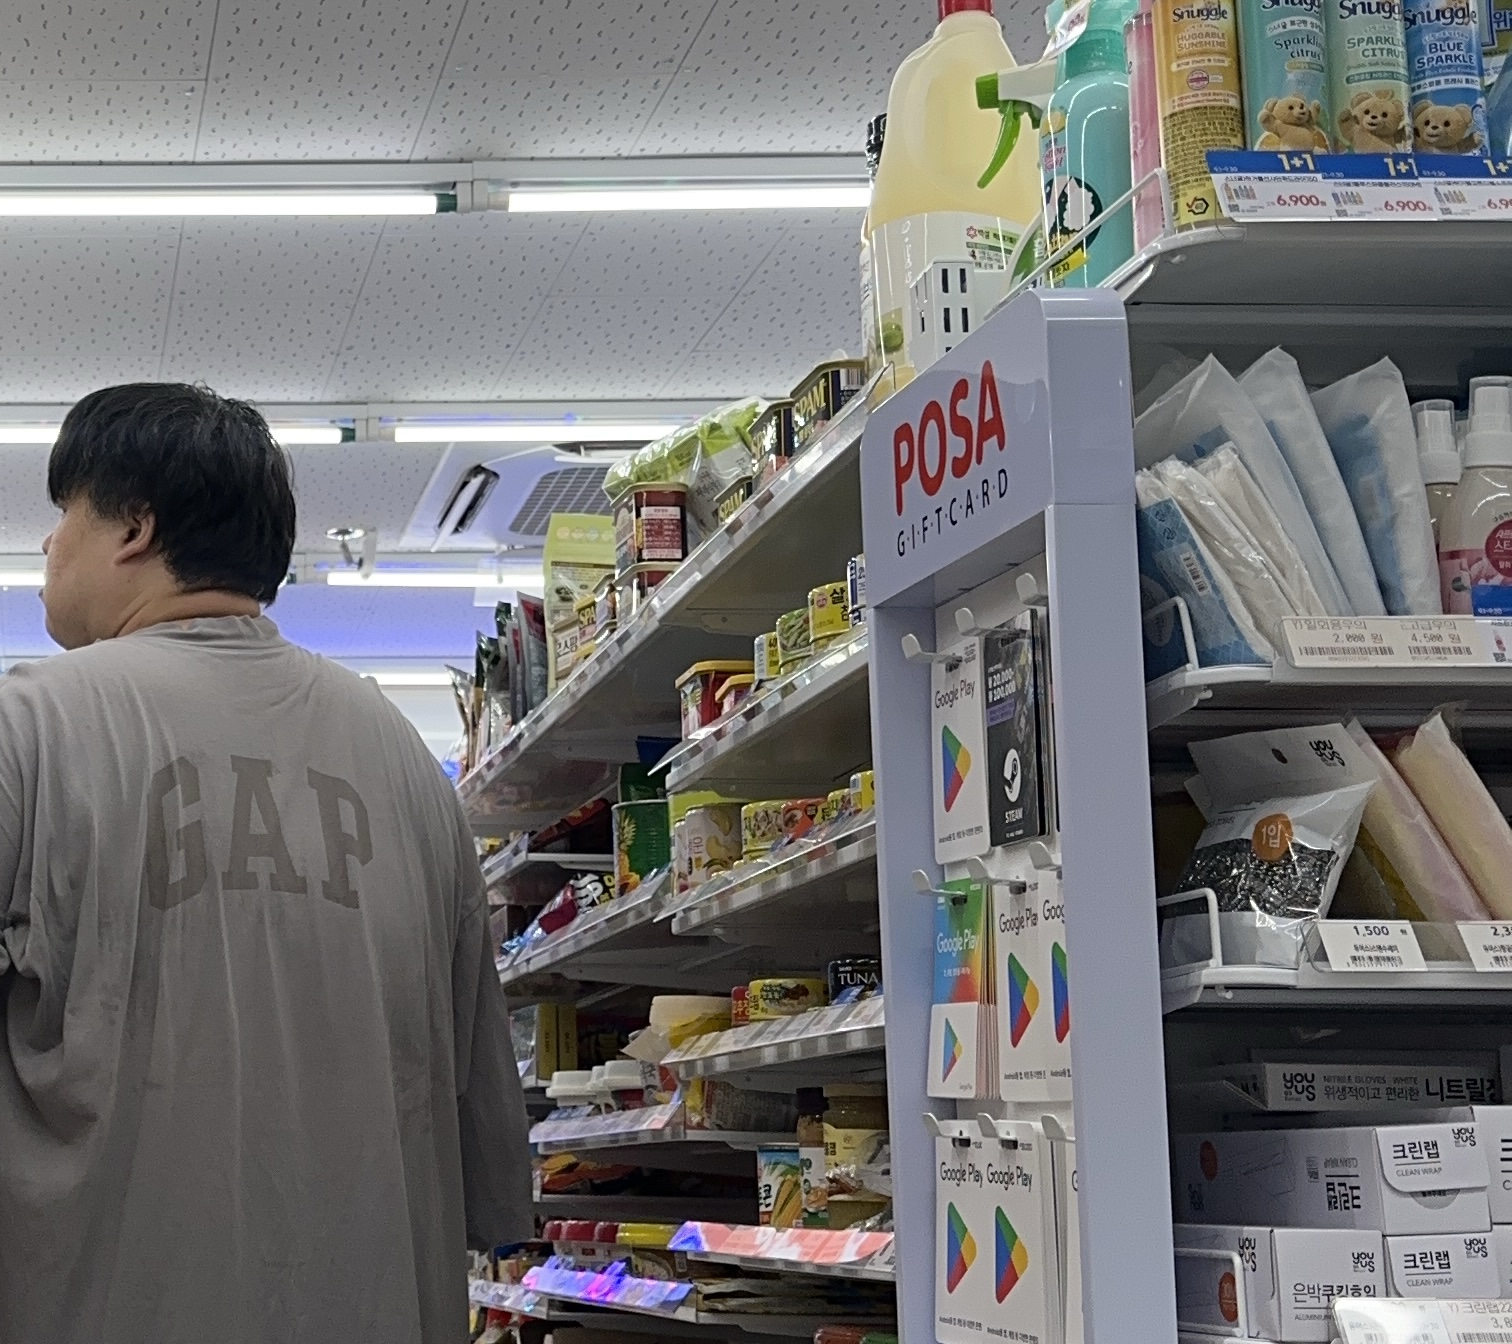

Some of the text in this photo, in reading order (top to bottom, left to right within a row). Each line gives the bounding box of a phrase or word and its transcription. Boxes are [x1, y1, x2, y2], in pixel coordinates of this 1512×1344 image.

[1172, 0, 1229, 23] Snuggle
[1428, 41, 1464, 55] BLUE
[1416, 54, 1476, 70] SPARKLE
[1278, 153, 1419, 176] 1+1 1+1
[792, 378, 827, 422] SPAM
[893, 359, 1006, 517] POSA
[578, 606, 596, 628] SPA
[1371, 632, 1384, 644] 원
[1449, 632, 1462, 644] 원
[935, 678, 976, 709] Google Play
[1004, 806, 1024, 825] STEAM
[146, 756, 375, 913] GAP
[1260, 820, 1284, 849] 1입
[999, 912, 1024, 937] Google
[1353, 925, 1390, 938] 1,500
[937, 928, 980, 958] Google Play
[838, 972, 879, 986] TUNA
[1282, 1072, 1316, 1089] you
[1354, 1075, 1387, 1085] GLOVES
[1393, 1076, 1418, 1085] WHITE
[1323, 1086, 1420, 1102] 위생적이고 편리한
[1452, 1127, 1475, 1140] you
[1392, 1139, 1440, 1160] 크린랩
[939, 1160, 984, 1189] Google Play
[986, 1162, 1033, 1193] Google Play
[1395, 1166, 1443, 1178] CLEAN WRAP
[1463, 1237, 1487, 1250] you
[1351, 1251, 1375, 1264] you
[1403, 1250, 1452, 1271] 크린랩
